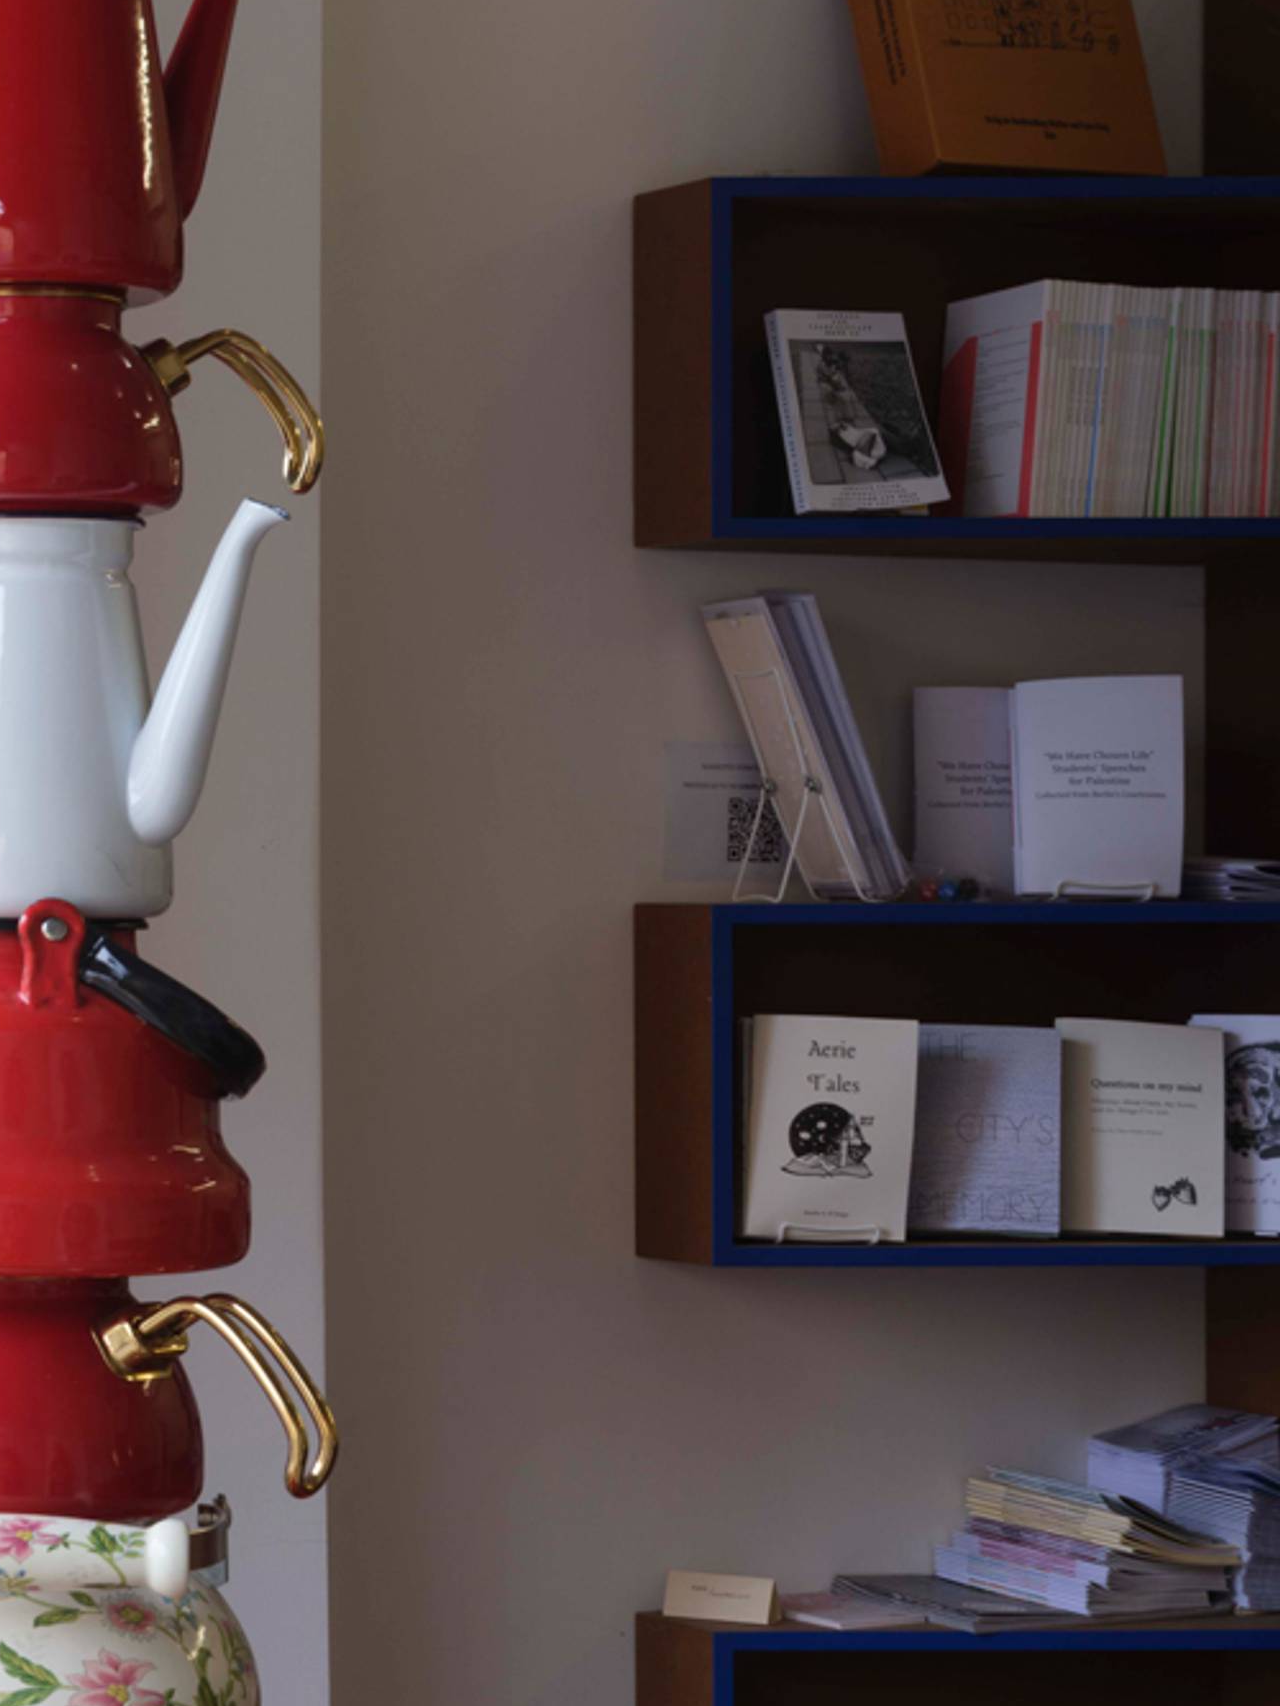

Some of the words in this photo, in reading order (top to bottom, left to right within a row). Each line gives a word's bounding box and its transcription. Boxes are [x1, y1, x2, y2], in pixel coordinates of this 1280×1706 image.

[807, 1039, 858, 1060] Aerie
[806, 1072, 862, 1093] Tales
[1089, 1077, 1141, 1091] Questions
[1142, 1082, 1156, 1091] on
[1176, 1082, 1204, 1093] mind
